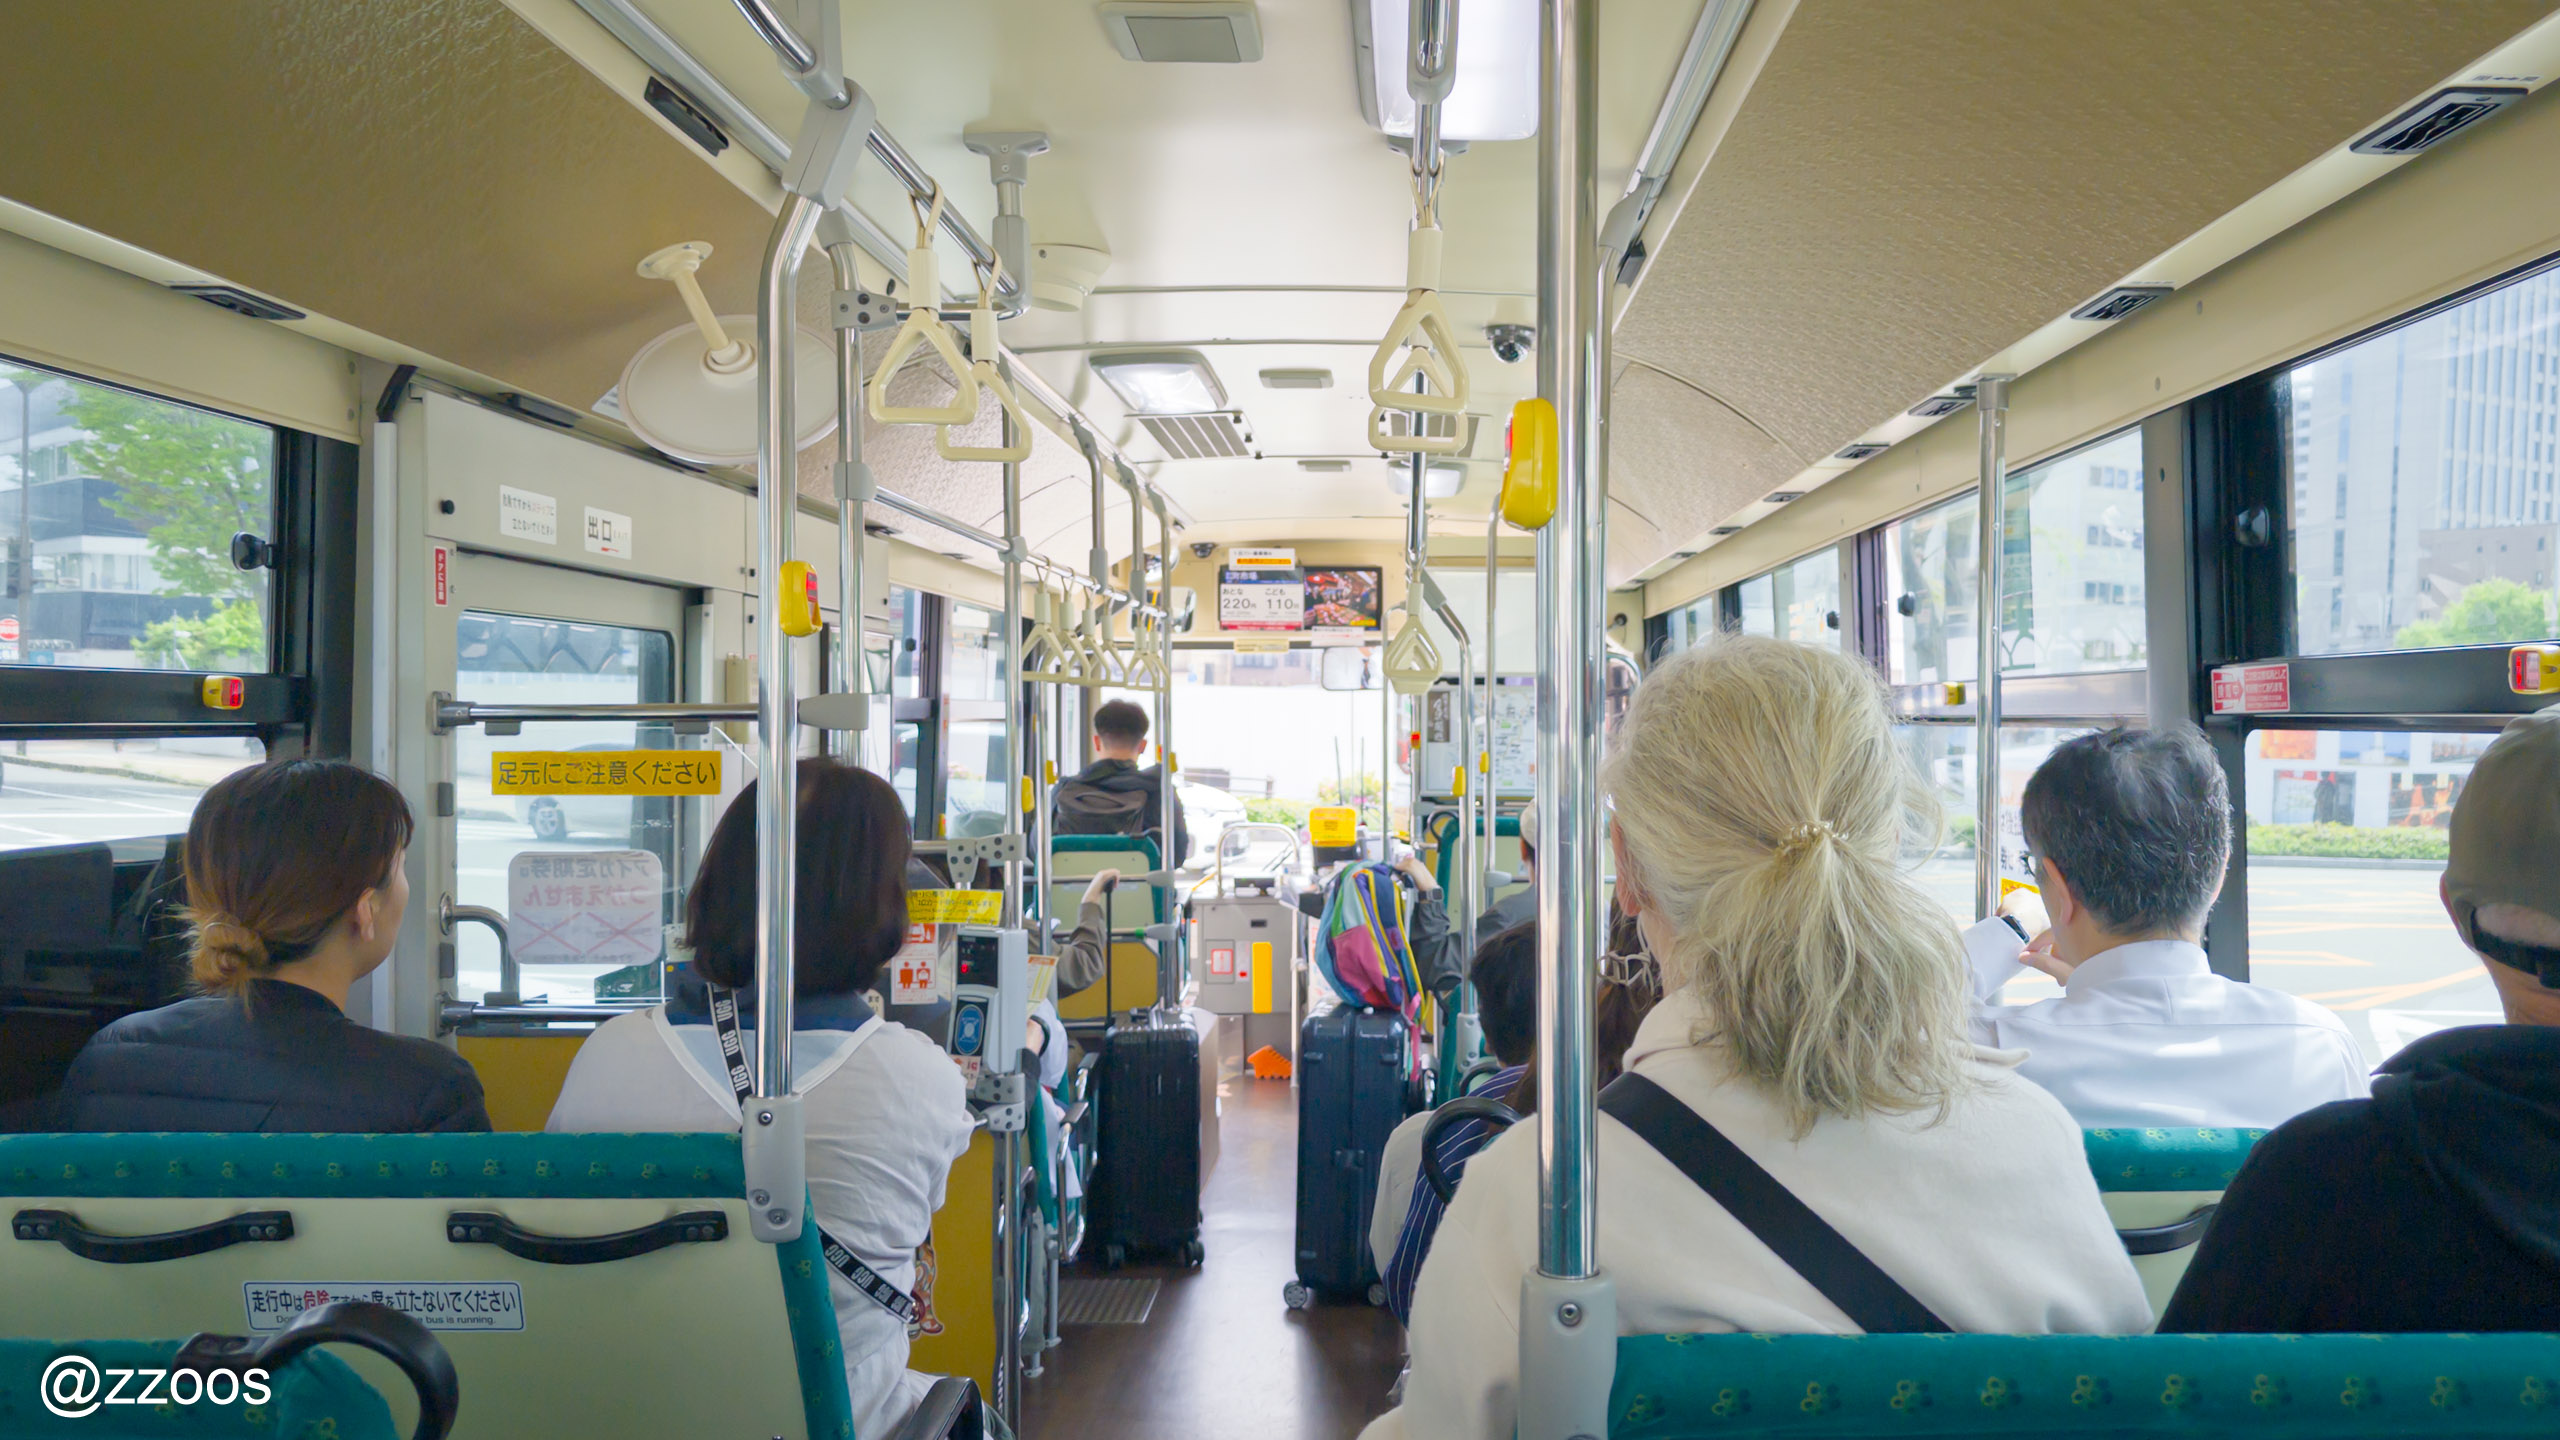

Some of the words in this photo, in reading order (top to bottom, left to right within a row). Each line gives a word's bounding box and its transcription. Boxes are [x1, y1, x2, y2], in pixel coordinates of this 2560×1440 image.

[588, 515, 611, 543] 出口
[1223, 588, 1243, 596] おとな
[1265, 588, 1286, 596] こども
[498, 760, 716, 786] 足元にご注意ください
[715, 1000, 734, 1022] UGG
[721, 1030, 740, 1057] UGG
[731, 1064, 749, 1091] UGG
[825, 1244, 851, 1268] UGG
[851, 1266, 875, 1289] UGG
[426, 1316, 444, 1324] bus
[446, 1316, 455, 1324] is
